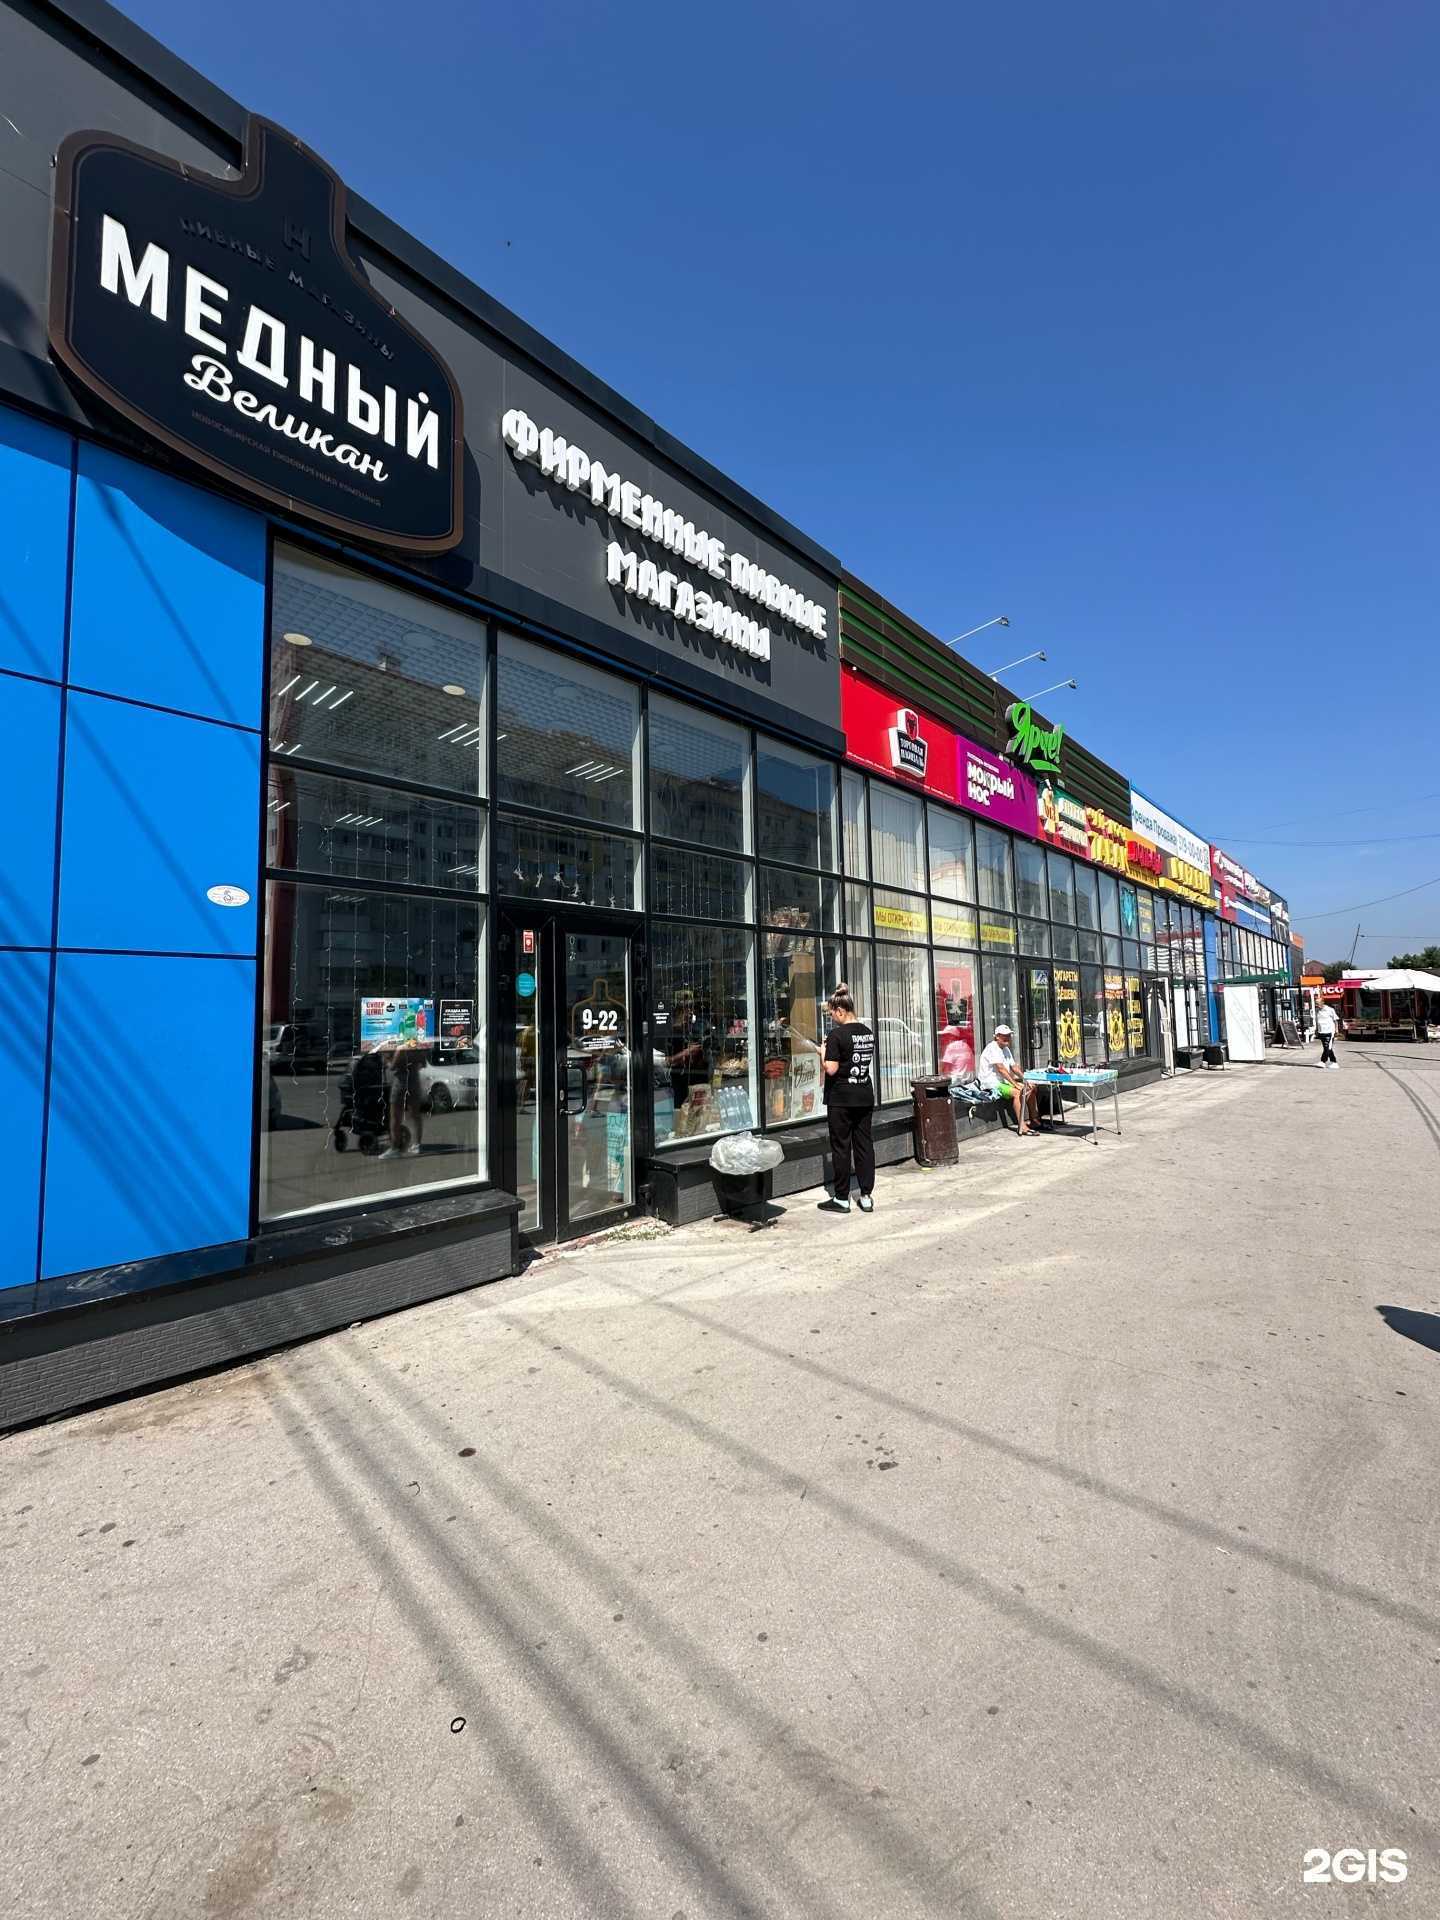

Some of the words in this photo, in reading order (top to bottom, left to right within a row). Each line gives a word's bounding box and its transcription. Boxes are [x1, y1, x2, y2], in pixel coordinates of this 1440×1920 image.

[101, 213, 439, 469] МЕДНЫЙ
[183, 354, 388, 482] Великан
[502, 409, 726, 579] ФИРМЕННЫЕ
[730, 552, 827, 640] ПИВНЫЕ
[606, 541, 770, 662] МАГАЗИНЫ
[583, 1009, 618, 1030] 9-22
